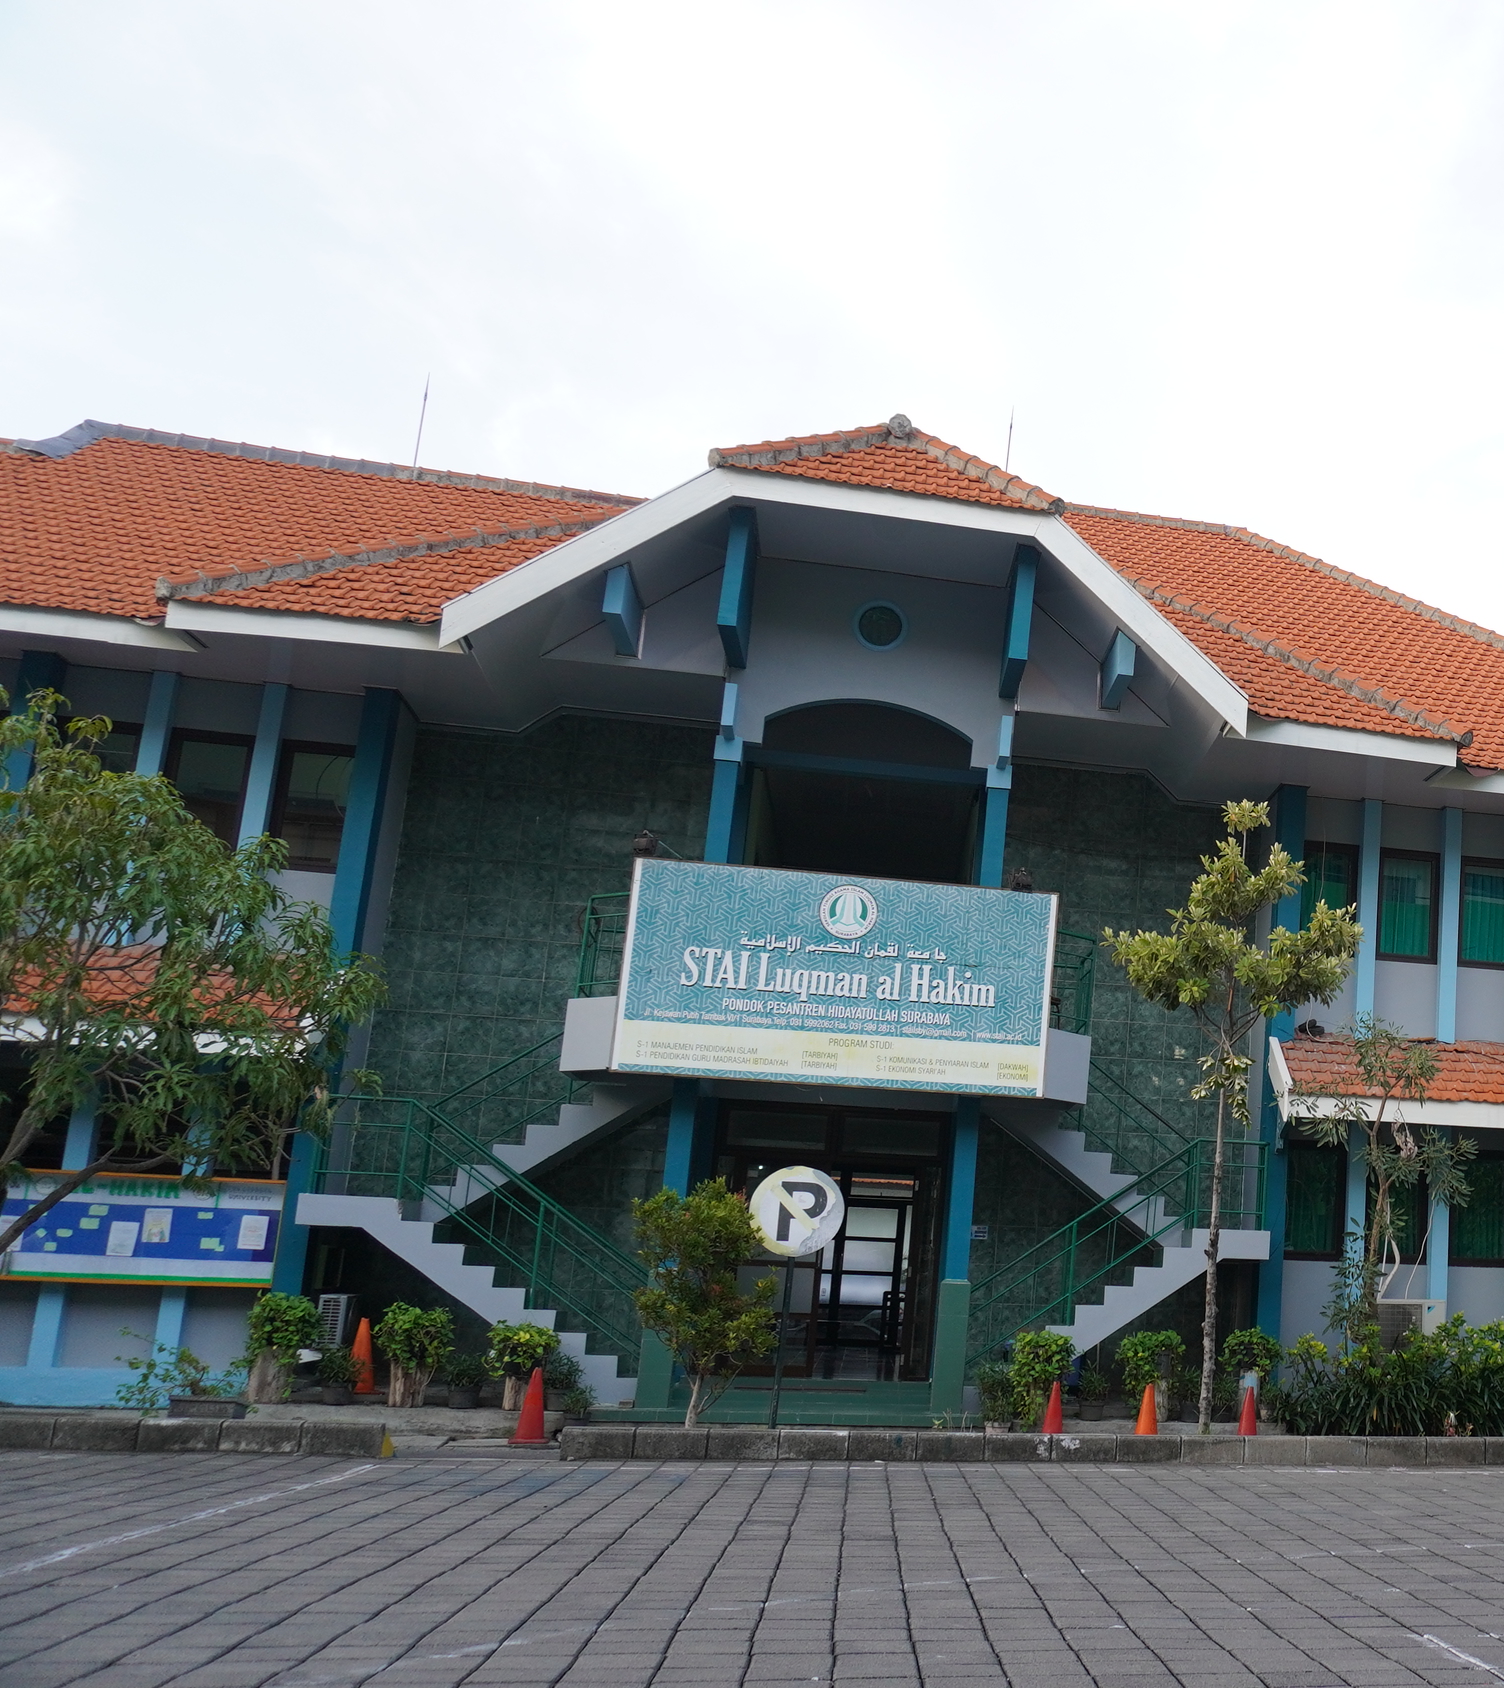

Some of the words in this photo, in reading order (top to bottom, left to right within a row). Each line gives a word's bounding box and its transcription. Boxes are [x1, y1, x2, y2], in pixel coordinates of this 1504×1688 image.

[805, 940, 861, 955] الحكيم
[864, 942, 899, 958] لقمان
[680, 946, 752, 990] STAI
[756, 952, 868, 1002] Luqman
[876, 962, 902, 1002] al
[909, 963, 996, 1008] Hakim
[653, 1009, 680, 1018] Kejawan
[682, 1010, 700, 1019] Putih
[700, 1012, 726, 1021] Tambak
[790, 1018, 802, 1026] 031
[849, 1022, 862, 1031] 031
[722, 998, 765, 1012] PONDOK
[767, 1001, 827, 1016] PESANTREN
[828, 1005, 898, 1022] HIDAYATULLAH
[900, 1010, 951, 1026] SURABAYA
[636, 1040, 648, 1048] S-1
[650, 1041, 694, 1052] MANAJEMEN
[695, 1044, 735, 1054] PENDIDIKAN
[737, 1046, 758, 1055] ISLAM
[802, 1050, 838, 1061] [TARBIYAH]
[828, 1037, 868, 1048] PROGRAM
[870, 1040, 895, 1050] STUDI:
[636, 1050, 648, 1058] S-1
[649, 1051, 690, 1060] PENDIDIKAN
[691, 1054, 711, 1062] GURU
[712, 1055, 751, 1064] MADRASAH
[752, 1058, 788, 1066] IBTIDAIYAH
[801, 1060, 838, 1071] [TARBIYAH]
[876, 1054, 887, 1062] S-1
[889, 1056, 928, 1066] KOMUNIKASI
[934, 1058, 969, 1068] PENYIARAN
[970, 1061, 990, 1069] ISLAM
[876, 1064, 886, 1072] S-1
[888, 1065, 916, 1074] EKONOMI
[917, 1067, 946, 1075] SYARI'AH
[776, 1181, 828, 1241] P
